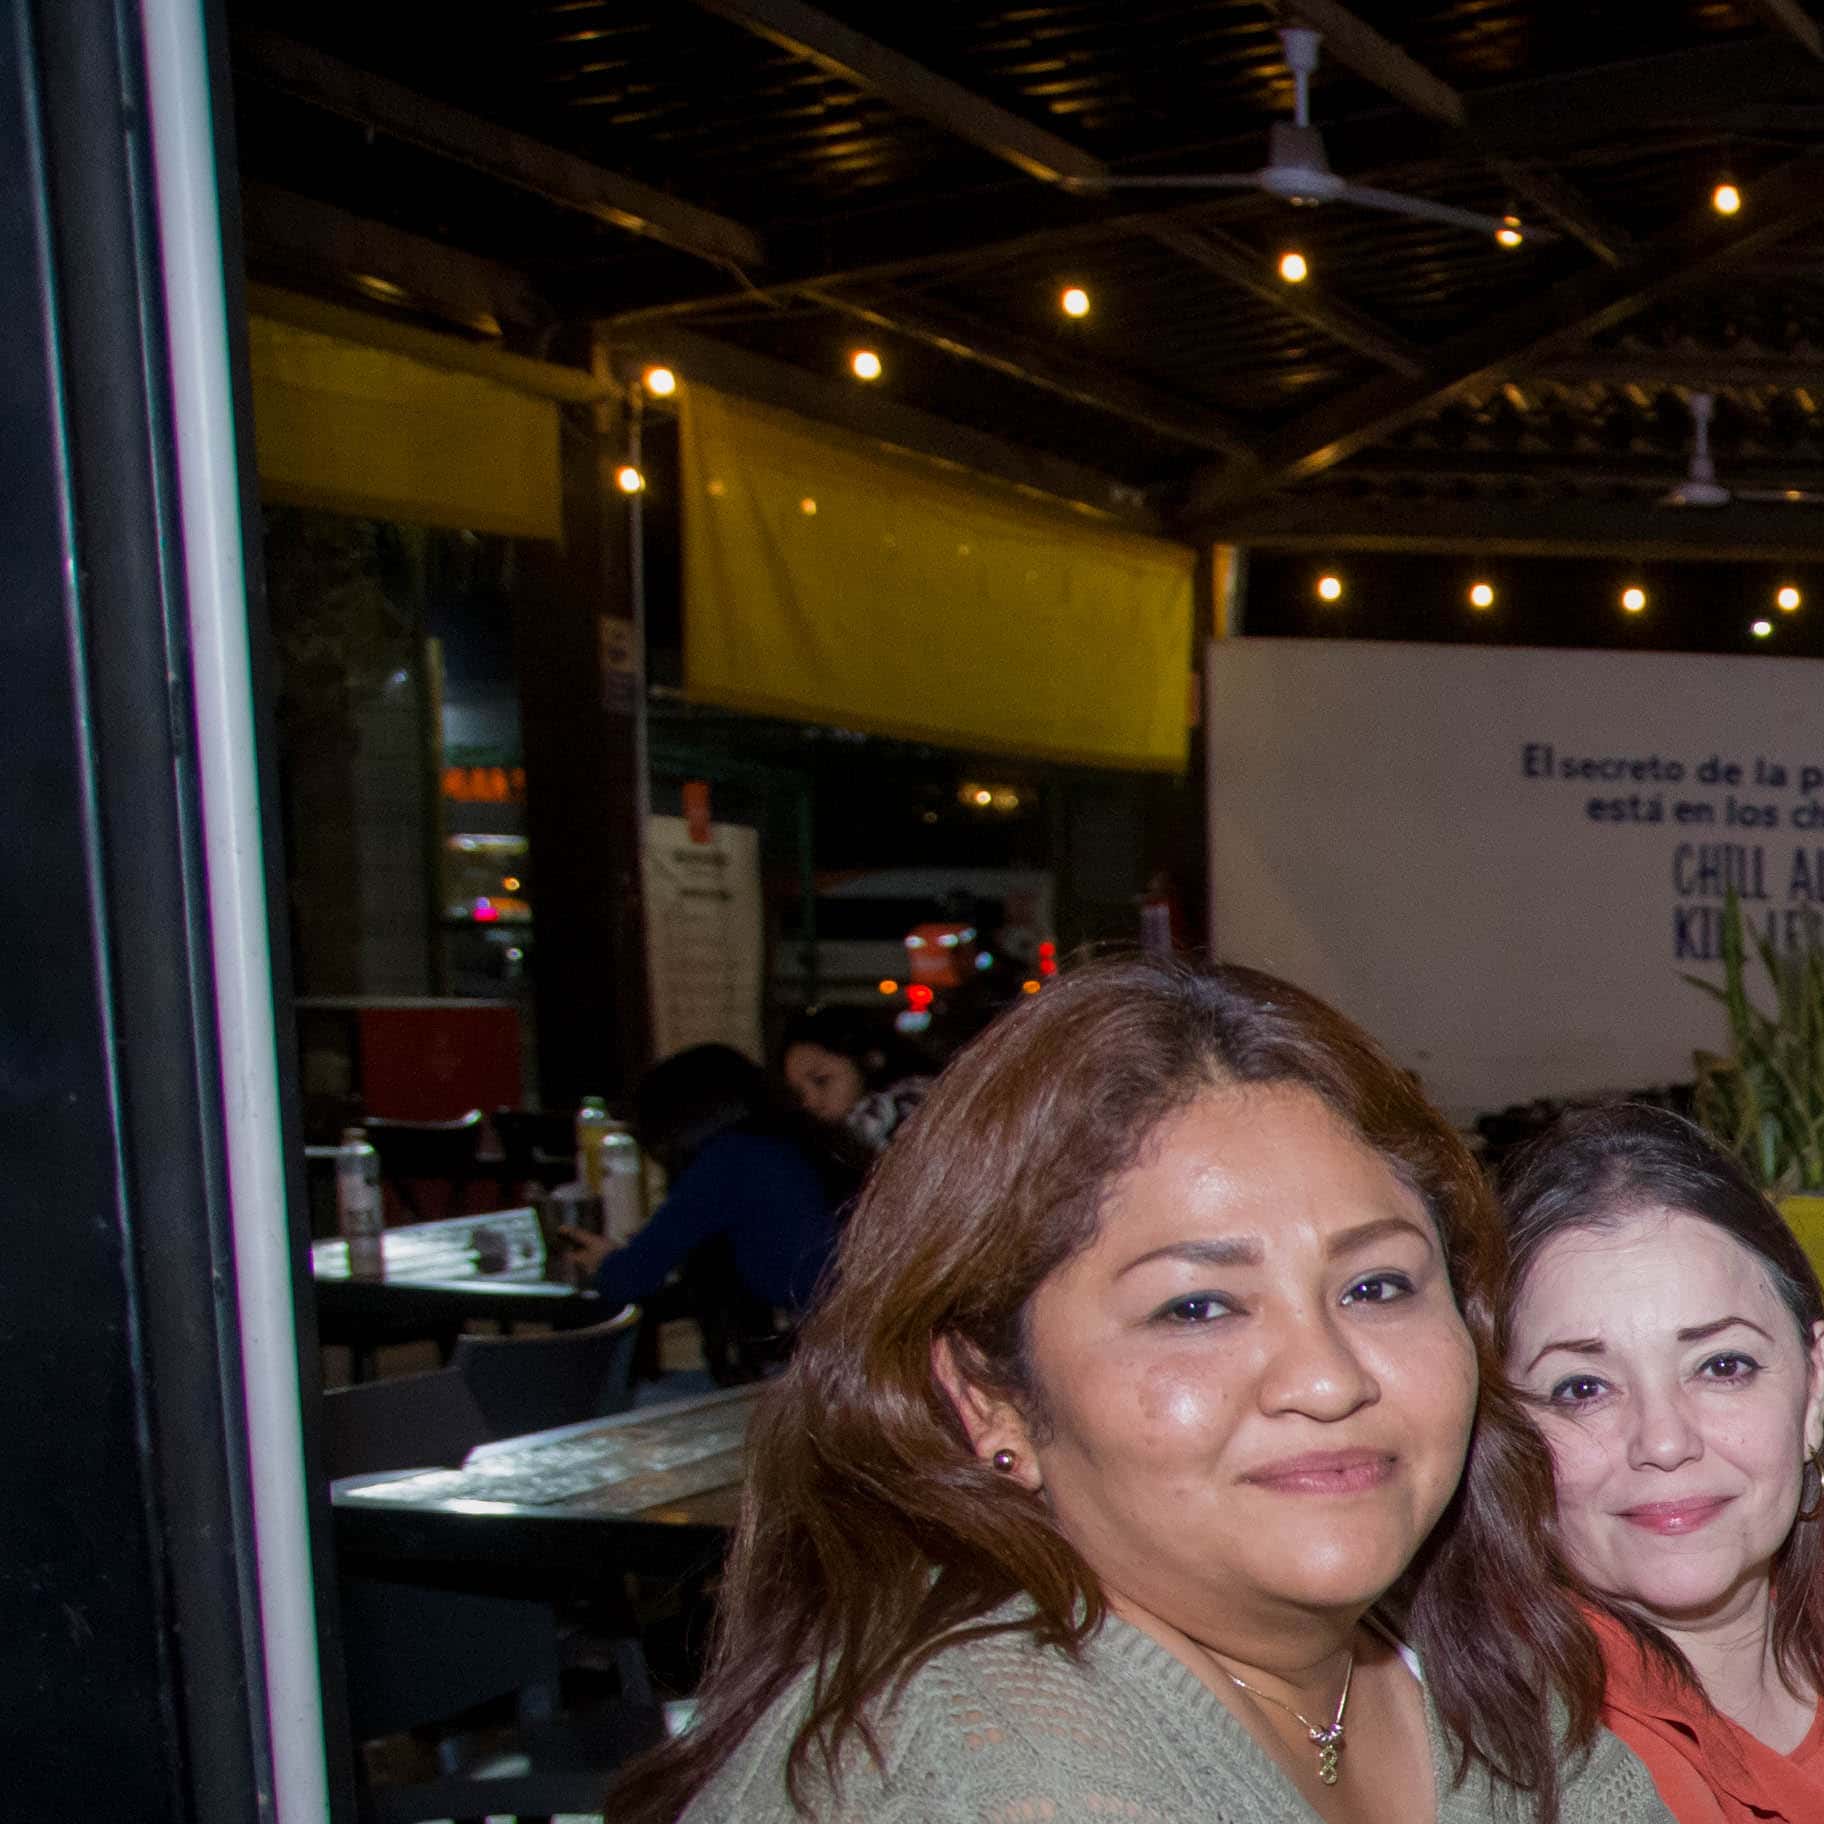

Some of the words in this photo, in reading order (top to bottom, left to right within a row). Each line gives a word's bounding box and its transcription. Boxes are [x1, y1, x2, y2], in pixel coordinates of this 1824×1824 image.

[1524, 743, 1553, 778] El
[1560, 756, 1686, 782] secreto
[1696, 754, 1743, 785] de
[1755, 756, 1787, 788] la
[1587, 793, 1664, 824] está
[1675, 801, 1714, 825] en
[1726, 796, 1778, 828] los
[1673, 841, 1768, 899] CHILL
